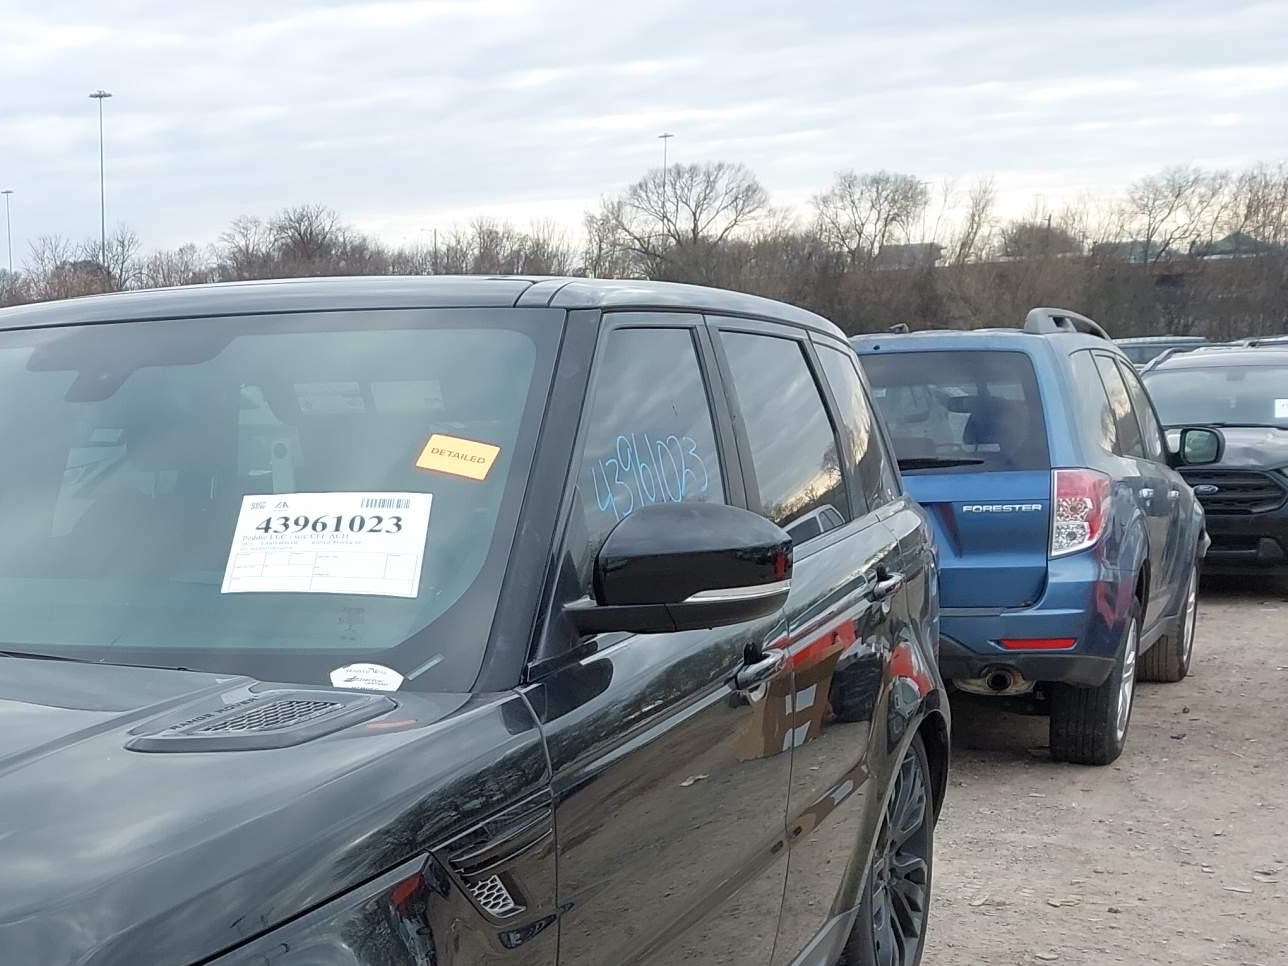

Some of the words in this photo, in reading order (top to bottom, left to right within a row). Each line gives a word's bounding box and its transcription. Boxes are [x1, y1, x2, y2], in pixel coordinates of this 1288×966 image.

[430, 446, 487, 464] DETAILED
[961, 503, 1043, 513] FORESTER
[255, 514, 404, 534] 43961023
